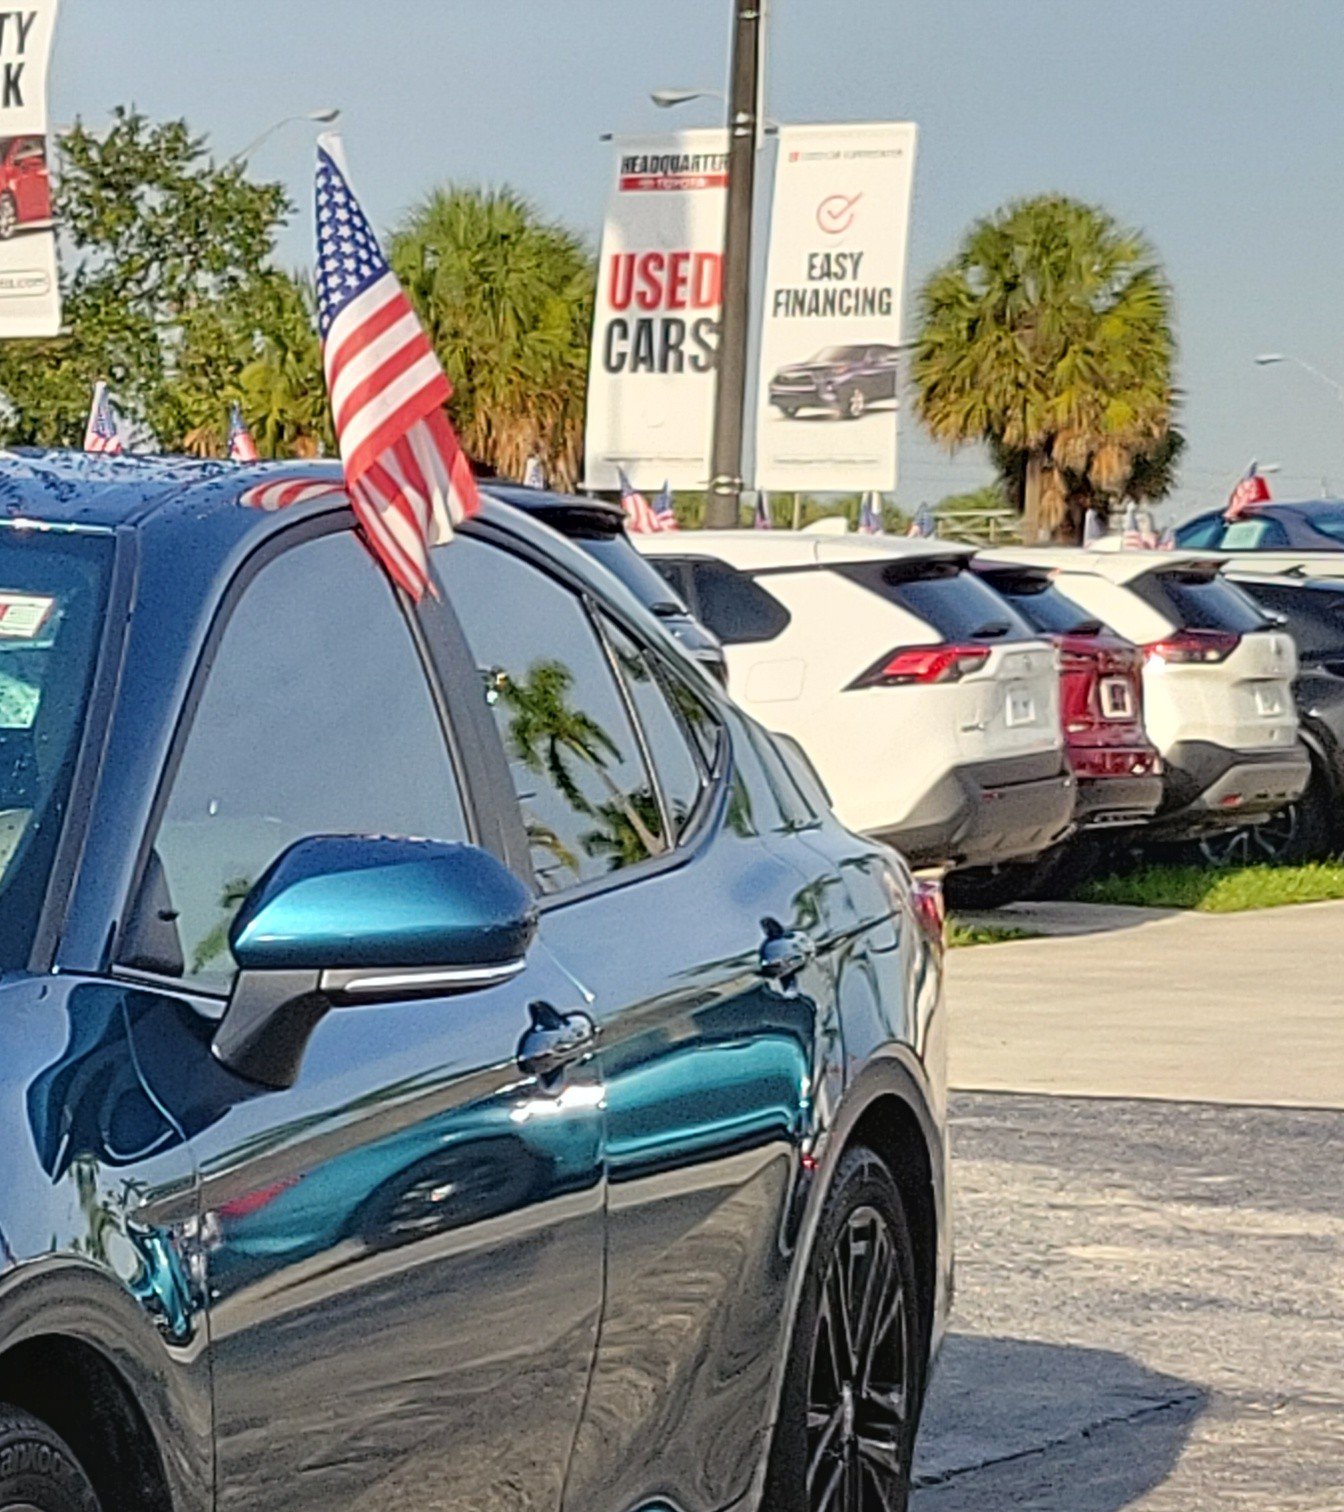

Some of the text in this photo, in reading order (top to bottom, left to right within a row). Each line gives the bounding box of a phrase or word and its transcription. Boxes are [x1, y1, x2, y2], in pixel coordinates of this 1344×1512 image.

[608, 251, 724, 312] USED
[807, 250, 864, 281] EASY
[772, 286, 892, 318] FINANCING
[603, 317, 721, 374] CARS
